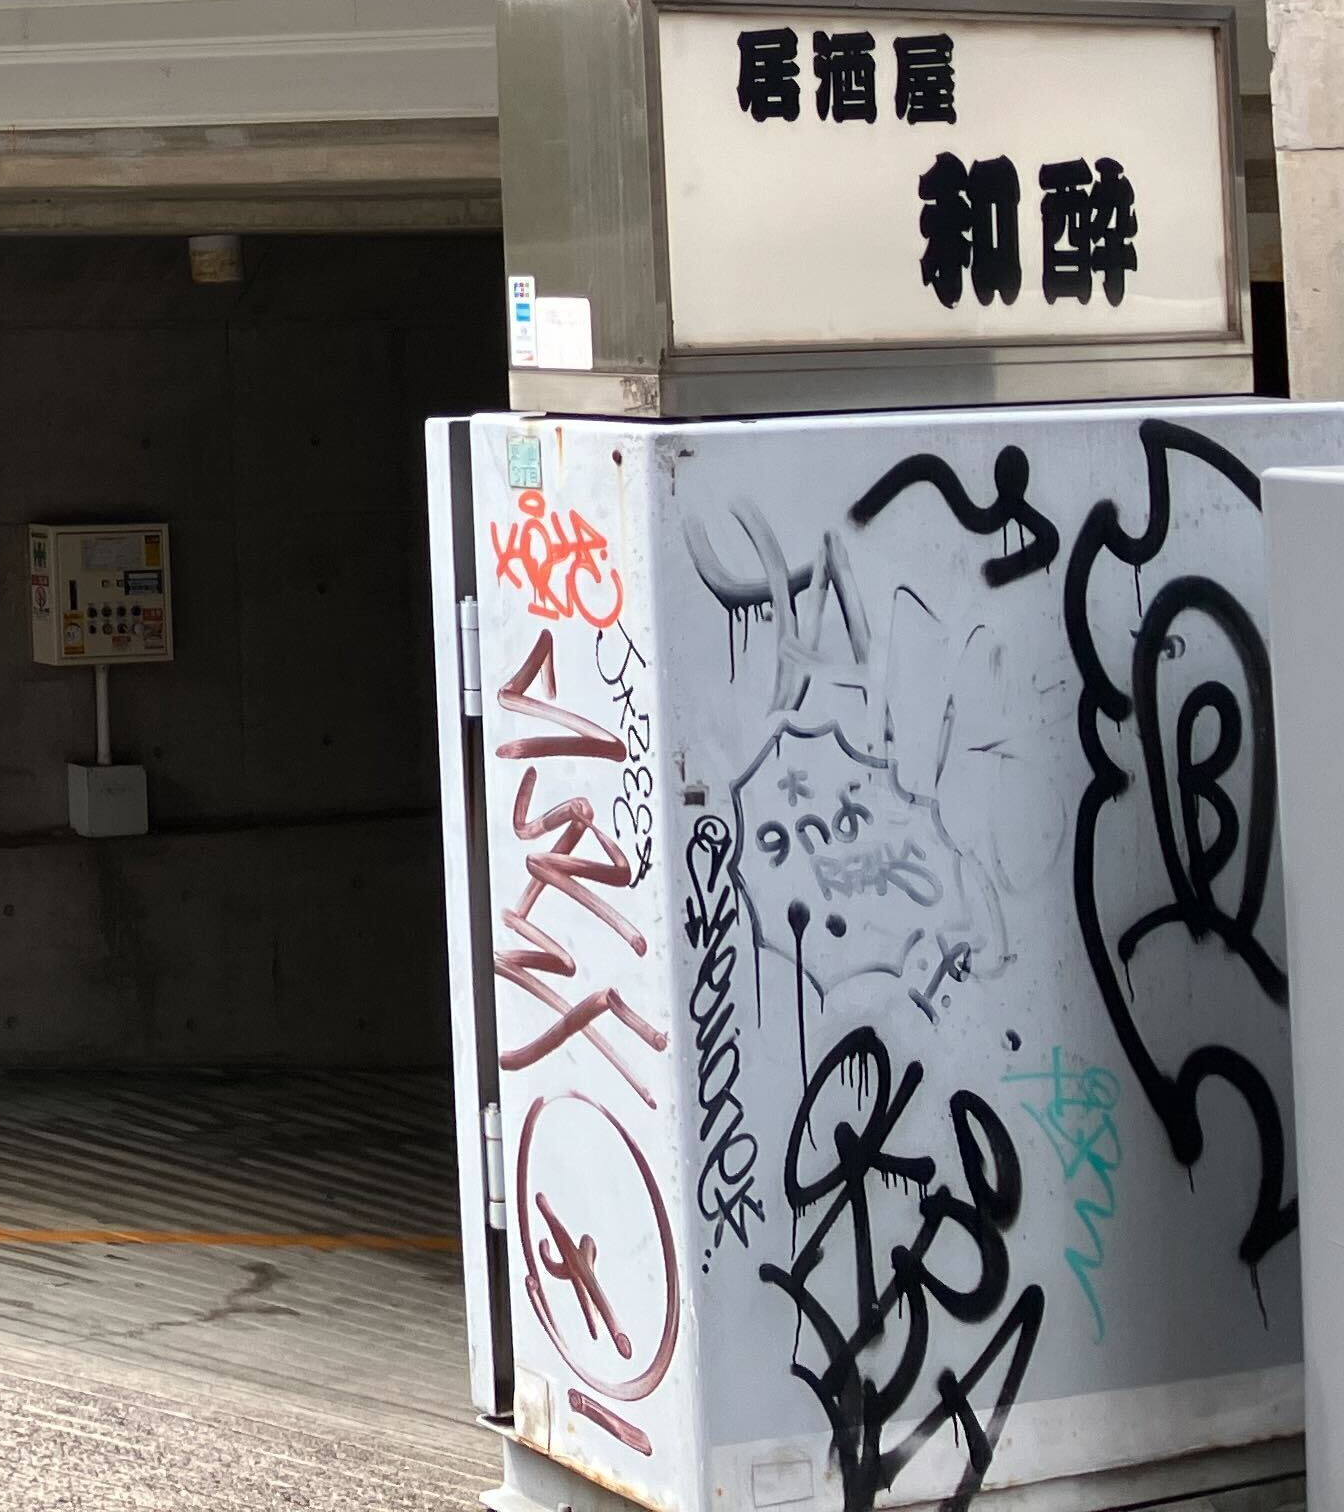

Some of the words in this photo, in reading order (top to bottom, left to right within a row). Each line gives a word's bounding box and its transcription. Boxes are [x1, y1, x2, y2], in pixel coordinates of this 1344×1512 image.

[737, 27, 958, 125] 居酒屋
[919, 150, 1139, 309] 和酔
